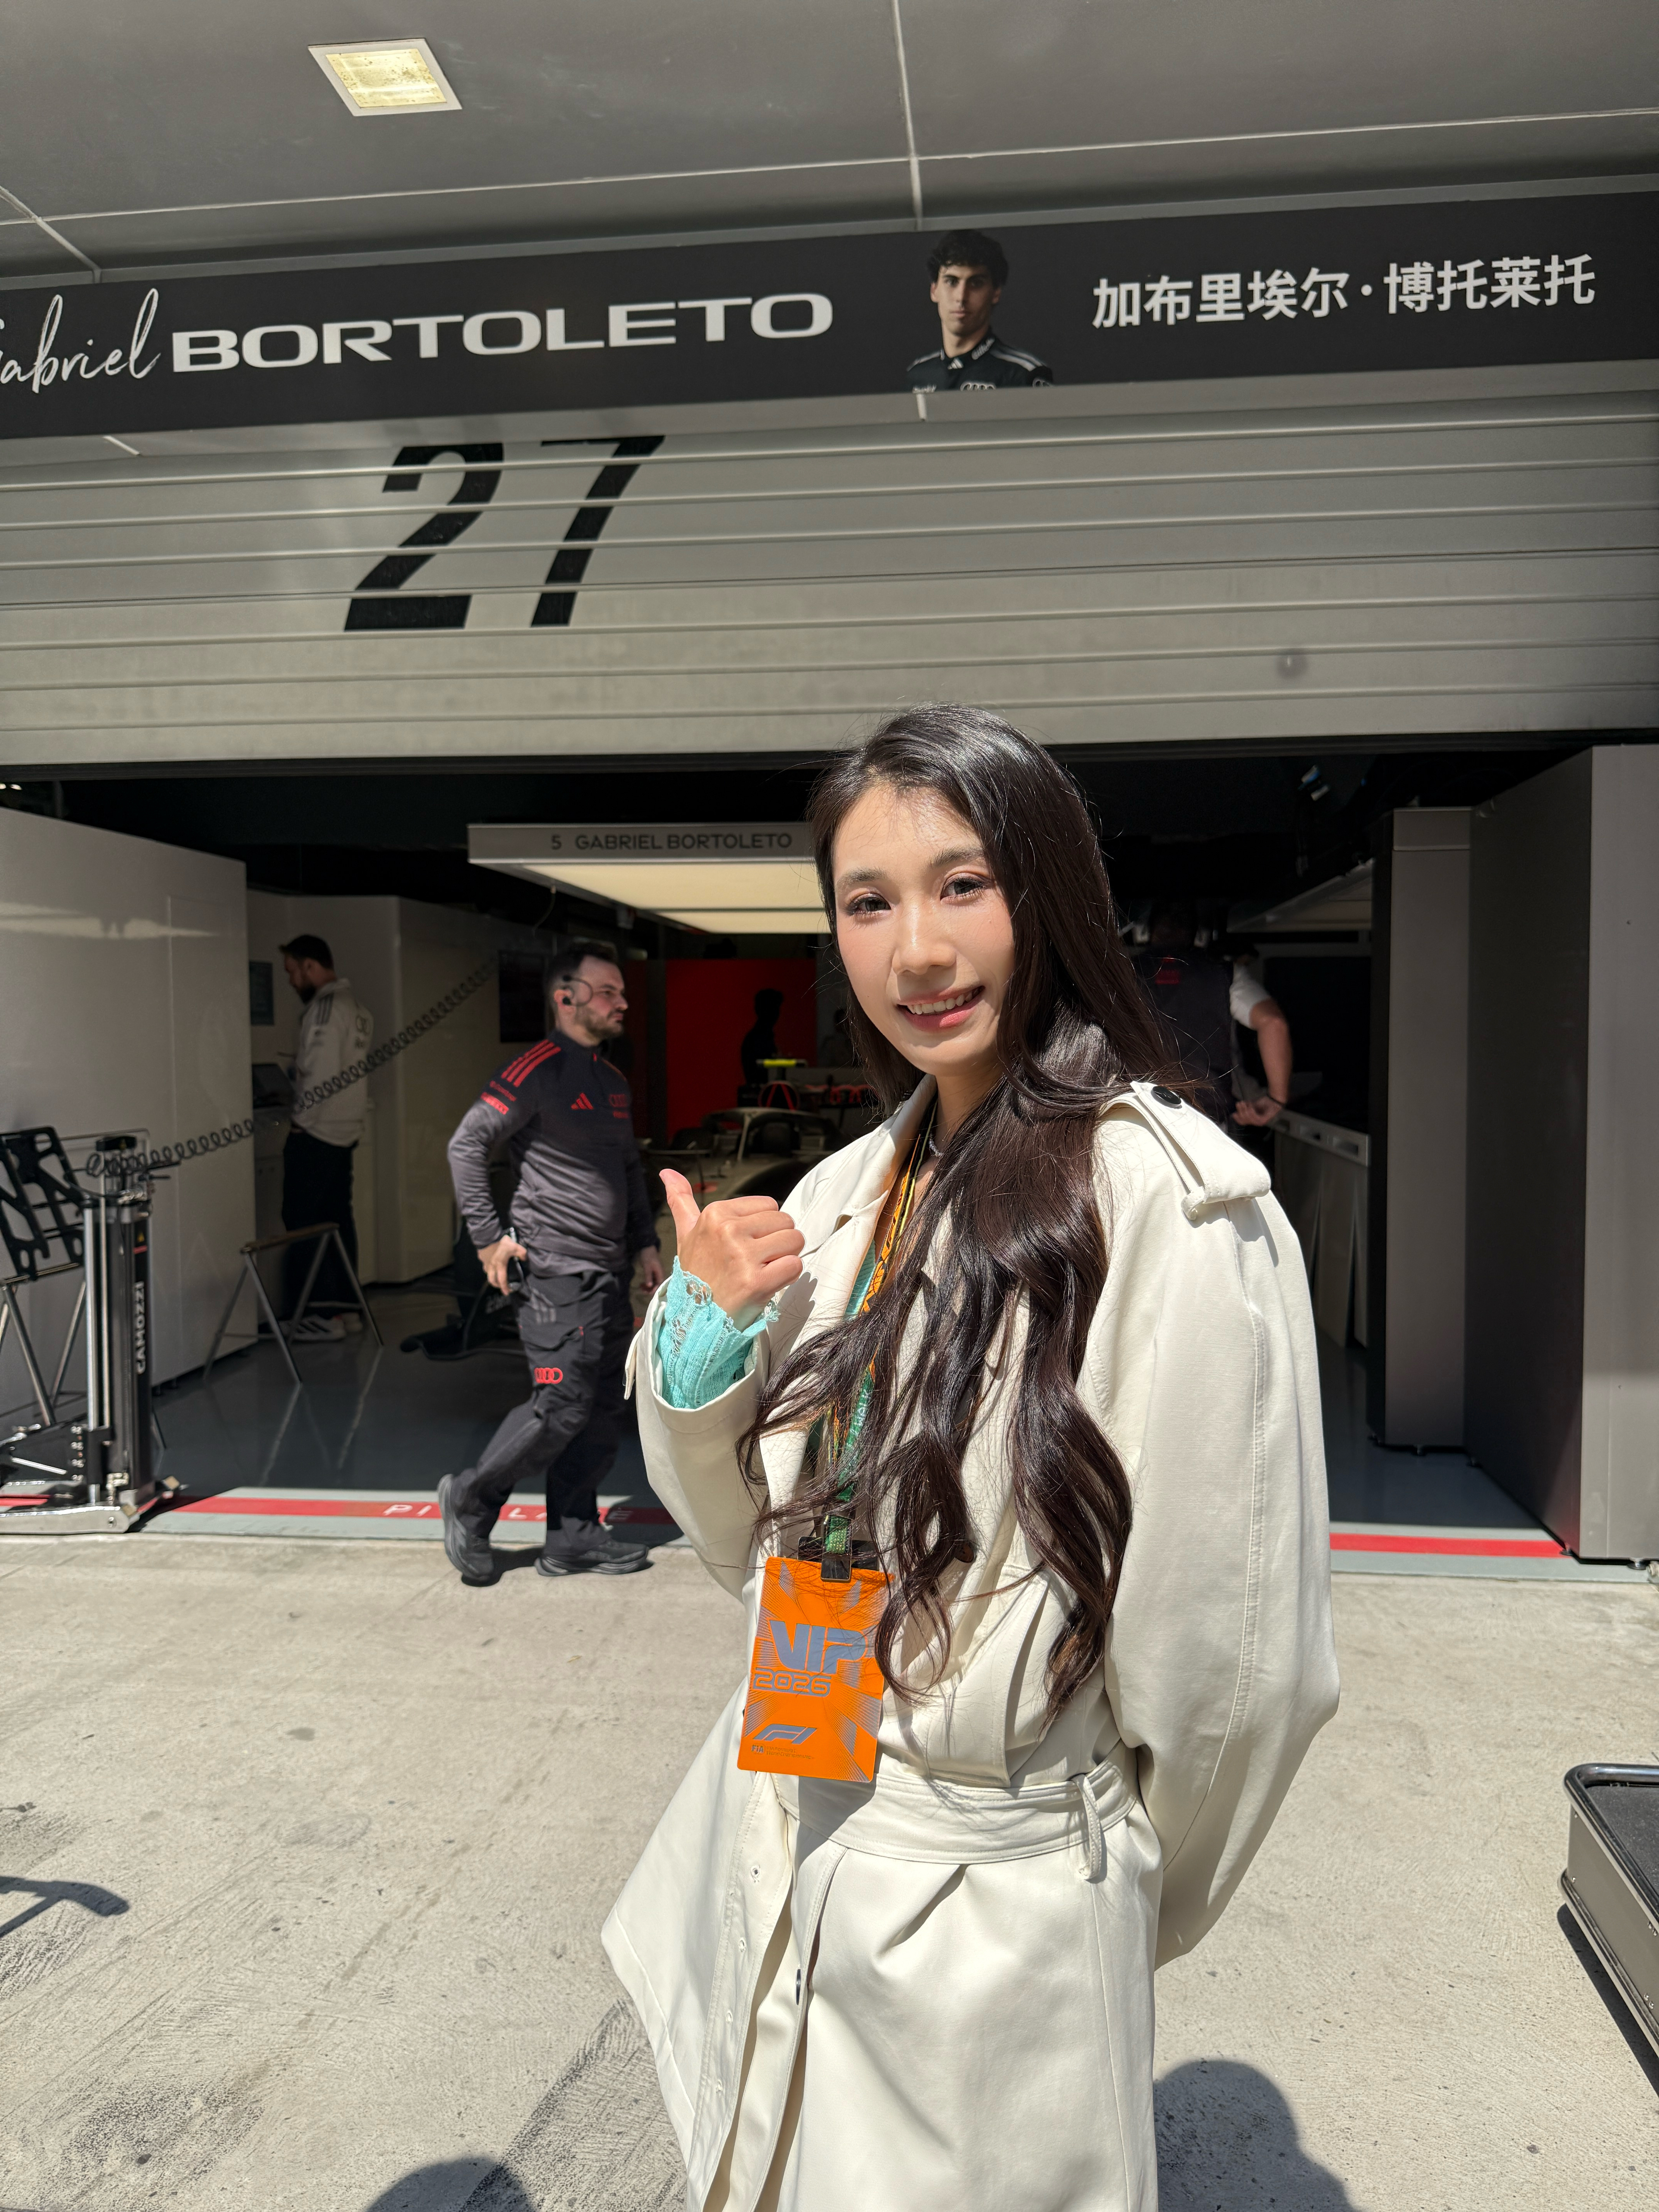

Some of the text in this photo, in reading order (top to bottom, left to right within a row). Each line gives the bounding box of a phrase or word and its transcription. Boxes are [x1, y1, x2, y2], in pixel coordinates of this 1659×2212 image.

[1092, 253, 1595, 328] 加布里埃尔·博托莱托
[0, 288, 833, 393] abriel BORTOLETO
[344, 434, 666, 631] 27
[551, 833, 793, 850] 5 GABRIEL BORTOLETO
[134, 1281, 146, 1374] CAMOZZI
[769, 1620, 866, 1674] VIP
[753, 1668, 832, 1697] 2026
[751, 1744, 765, 1754] FIA
[753, 1723, 817, 1745] F1
